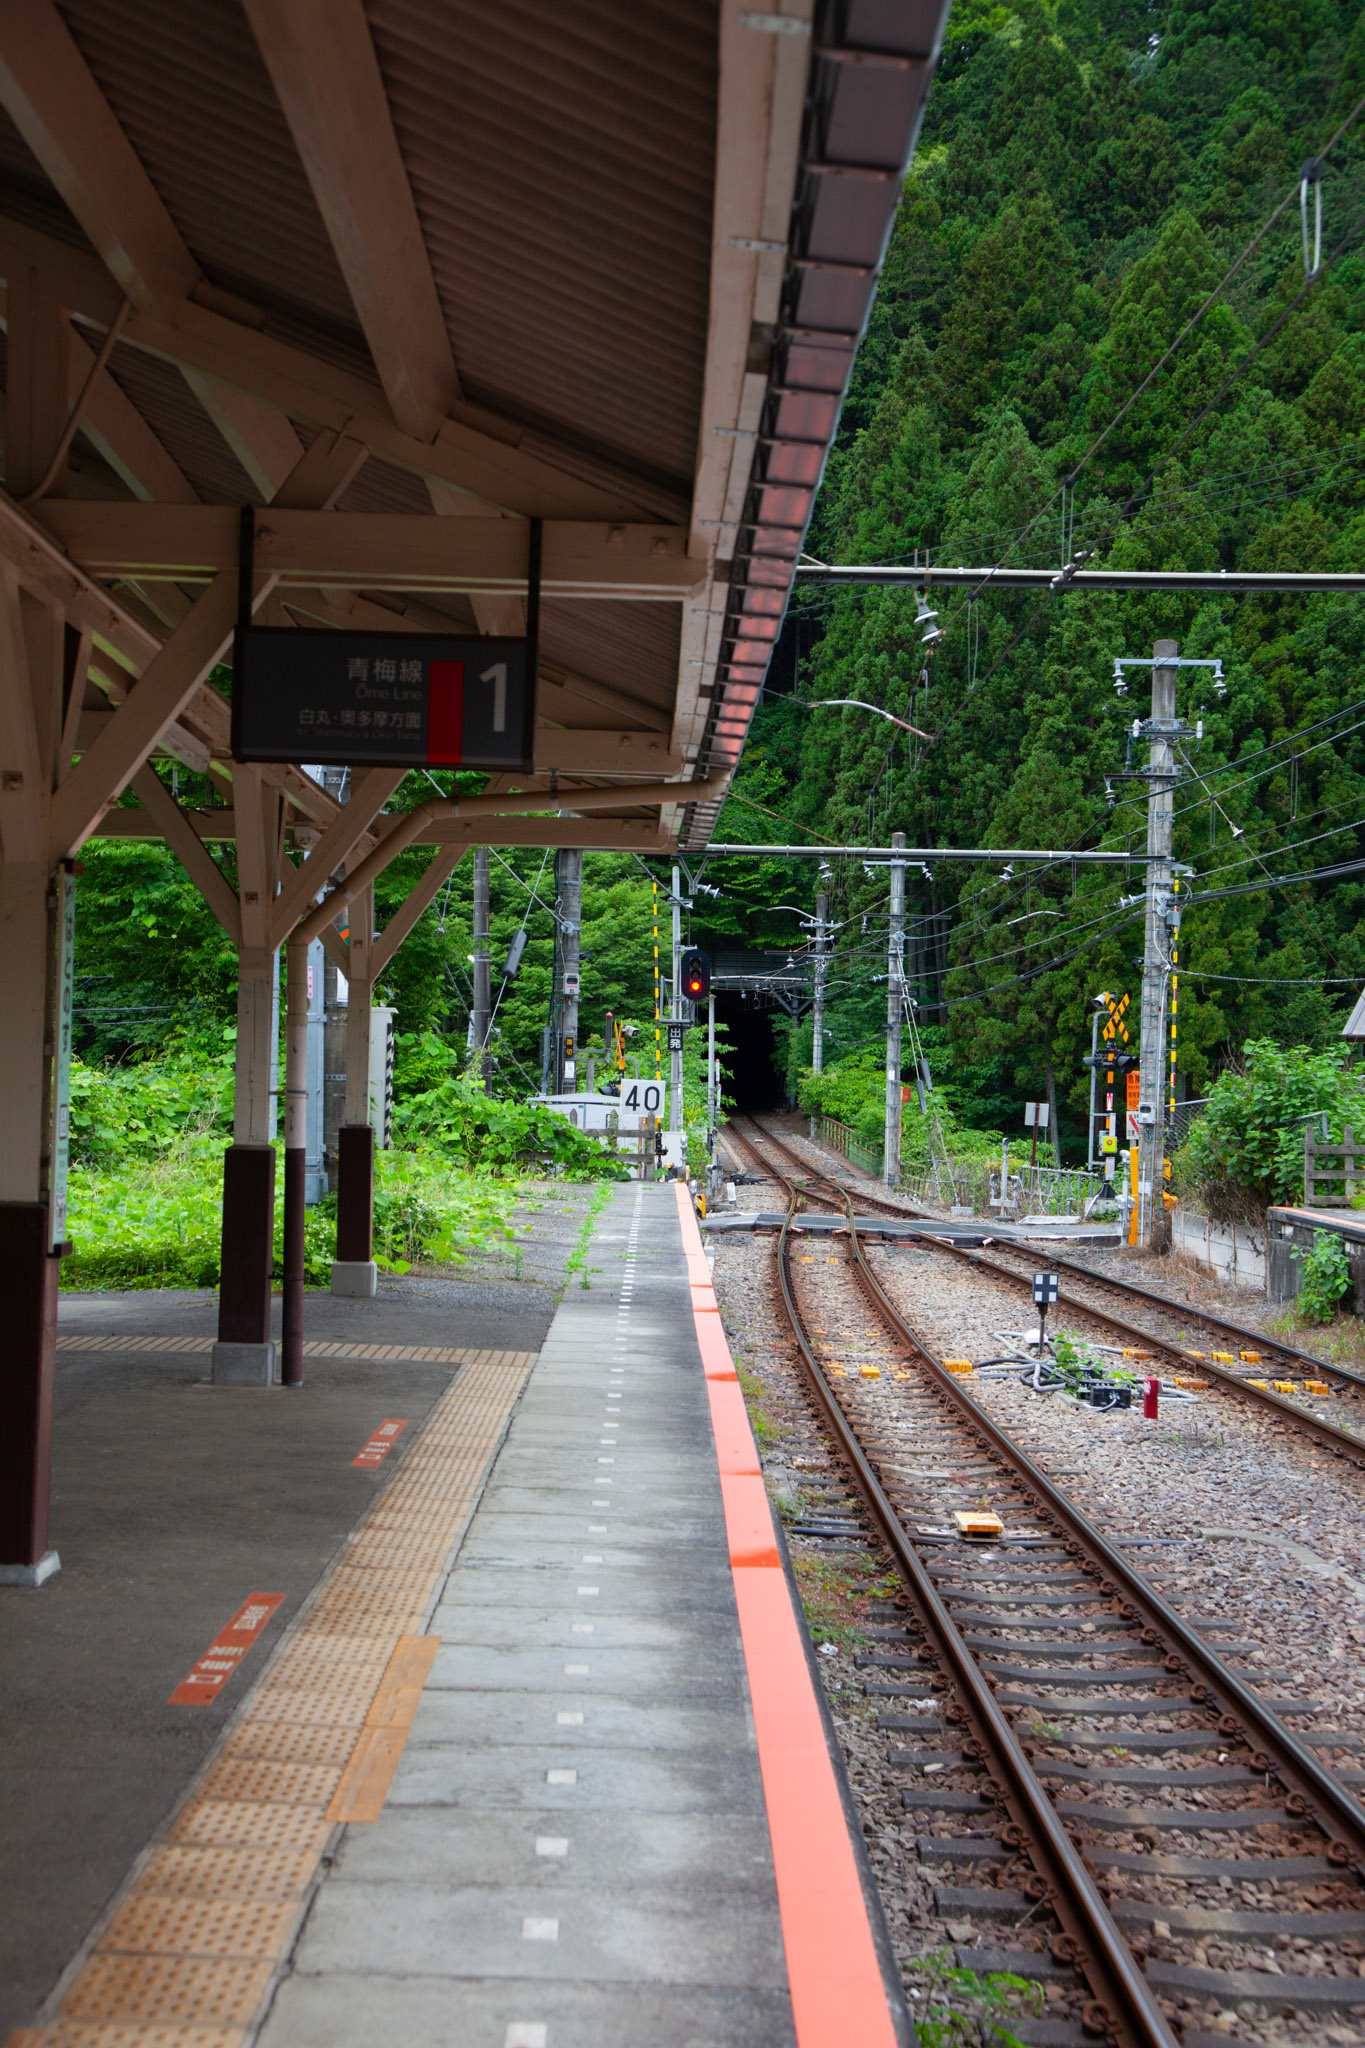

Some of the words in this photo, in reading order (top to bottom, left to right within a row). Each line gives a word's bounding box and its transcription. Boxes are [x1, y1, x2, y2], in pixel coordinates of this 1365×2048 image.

[347, 657, 423, 683] 青梅線
[393, 687, 423, 702] Line
[479, 662, 508, 733] 1
[669, 1027, 682, 1049] 出発
[625, 1085, 660, 1112] 40
